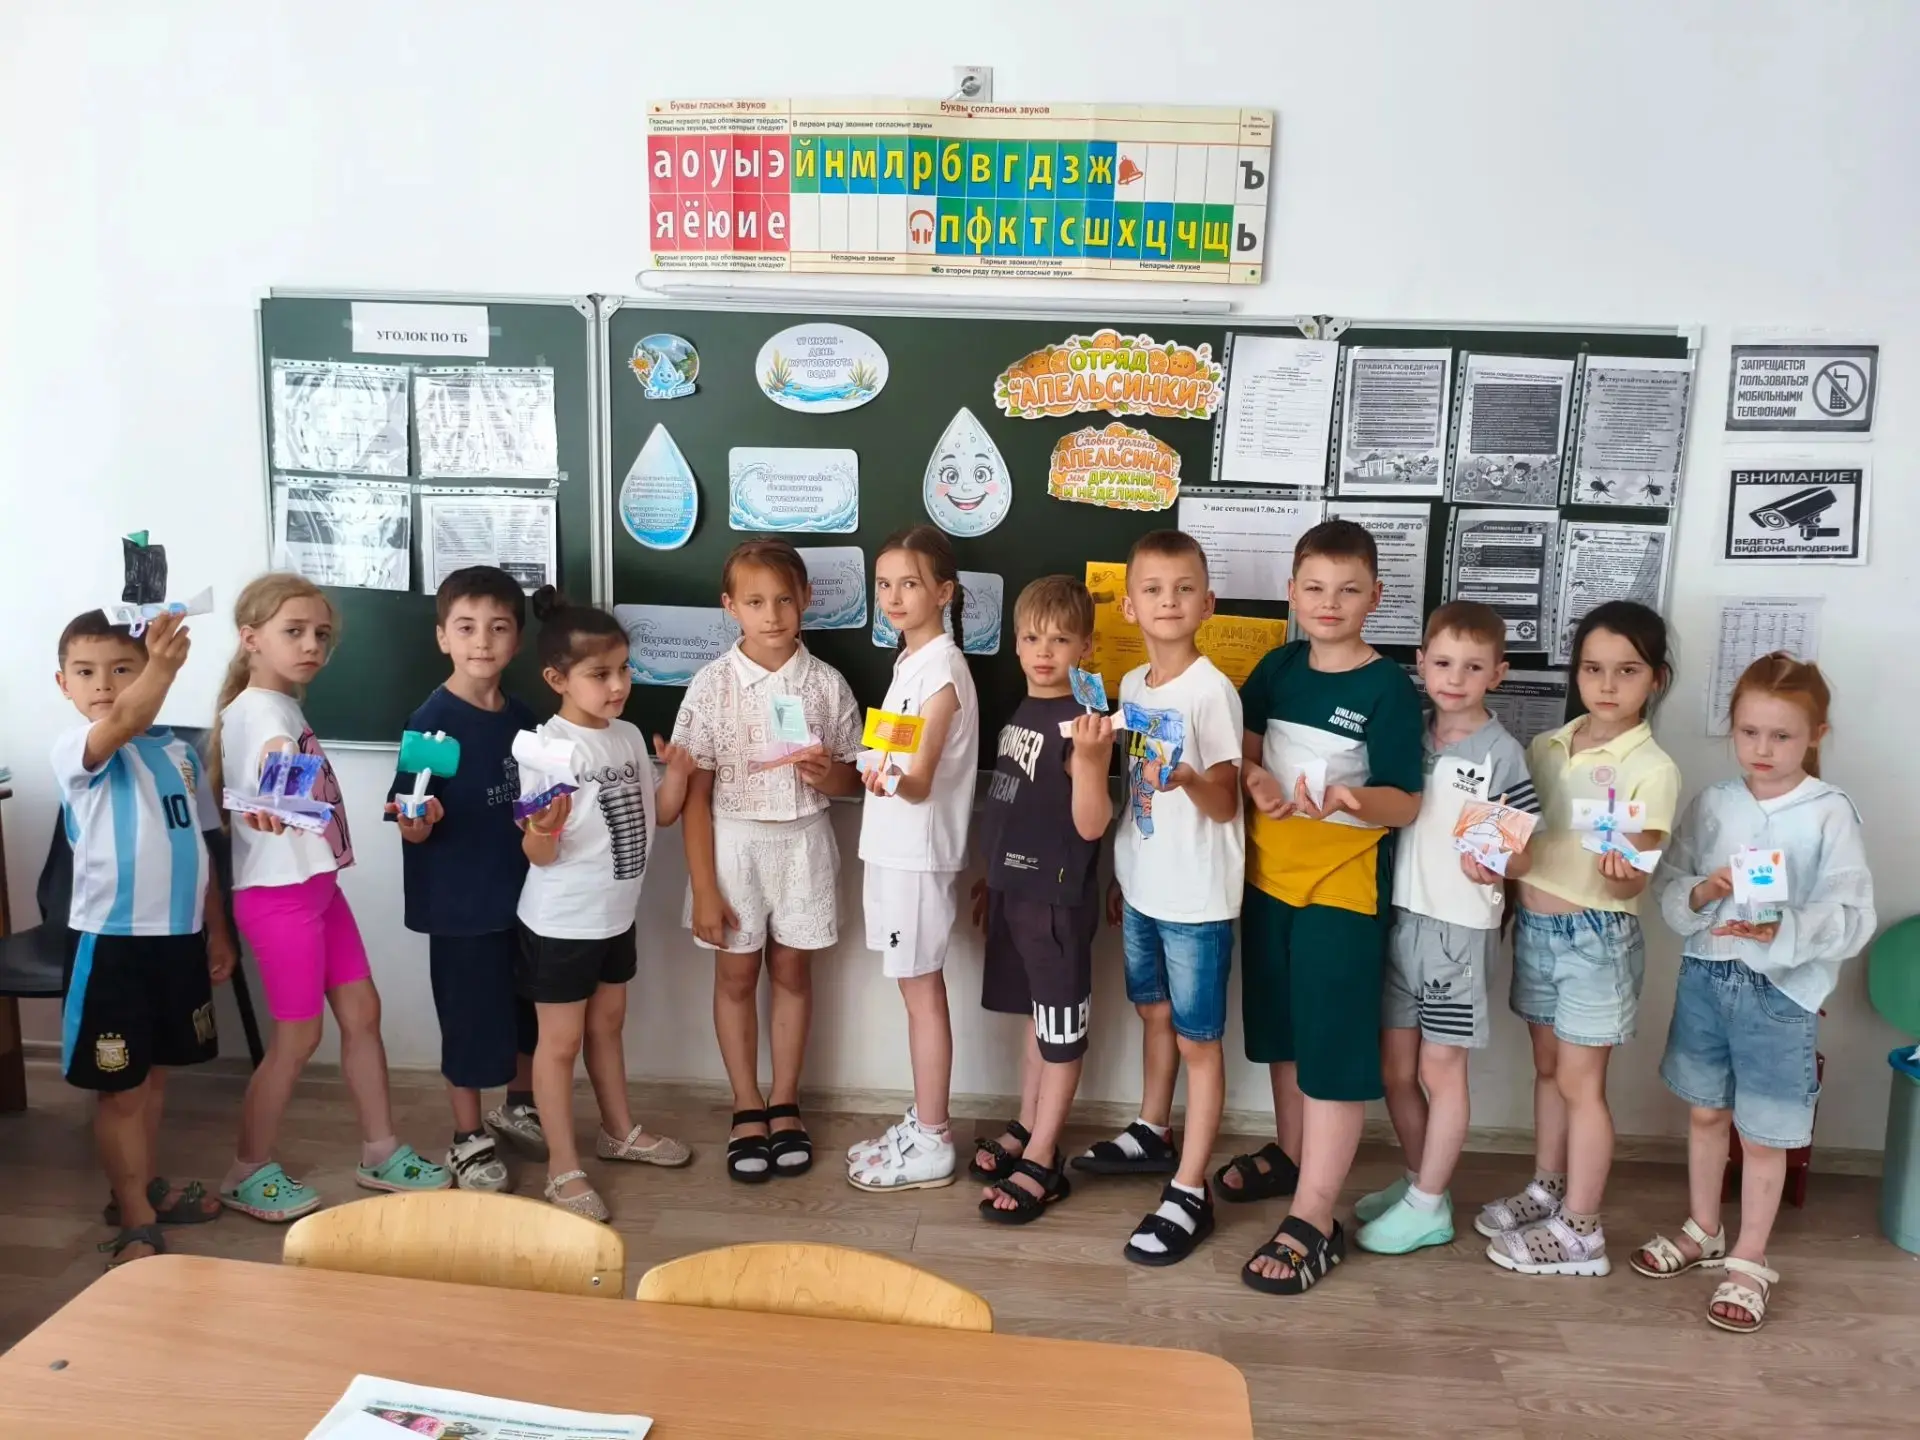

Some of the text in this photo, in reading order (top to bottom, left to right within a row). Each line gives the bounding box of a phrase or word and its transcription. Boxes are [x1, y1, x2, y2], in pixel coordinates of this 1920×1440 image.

[670, 101, 697, 110] Буквы
[736, 102, 766, 110] звуков
[940, 102, 1050, 115] Буквы согласных звуков
[827, 122, 844, 130] ряду
[912, 122, 932, 130] звуки
[830, 254, 866, 262] Непарные
[980, 258, 1062, 268] Парные звонкие/глухие
[972, 268, 989, 276] ряду
[1140, 262, 1200, 272] Непарные глухие
[376, 330, 468, 344] УГОЛОК ПО ТБ
[808, 336, 838, 346] ИЮНЯ
[808, 348, 835, 357] ДЕНЬ
[788, 358, 854, 368] КРУГОВОРОТА
[1069, 349, 1149, 373] ОТРЯД
[1741, 360, 1806, 371] ЗАПРЕЩАЕТСЯ
[806, 370, 836, 379] ВОДЫ
[1739, 376, 1808, 386] ПОЛЬЗОВАТЬСЯ
[1738, 390, 1803, 402] МОБИЛЬНЫМИ
[1736, 406, 1796, 417] ТЕЛЕФОНАМИ
[1075, 433, 1156, 451] Словно дольки
[1067, 470, 1156, 486] мы ДРУЖНЫ
[1736, 472, 1858, 484] ВНИМАНИЕ!
[1064, 486, 1166, 502] И НЕДЕЛИМЫ!
[1360, 521, 1422, 530] пасное лето
[1734, 545, 1850, 553] ВИДЕОНАБЛЮДЕНИЕ
[641, 634, 680, 646] Береги
[682, 636, 708, 649] воду
[640, 647, 678, 660] береги
[1334, 706, 1368, 724] UNLIMITE
[163, 794, 191, 829] 10
[1006, 852, 1026, 860] FASTER
